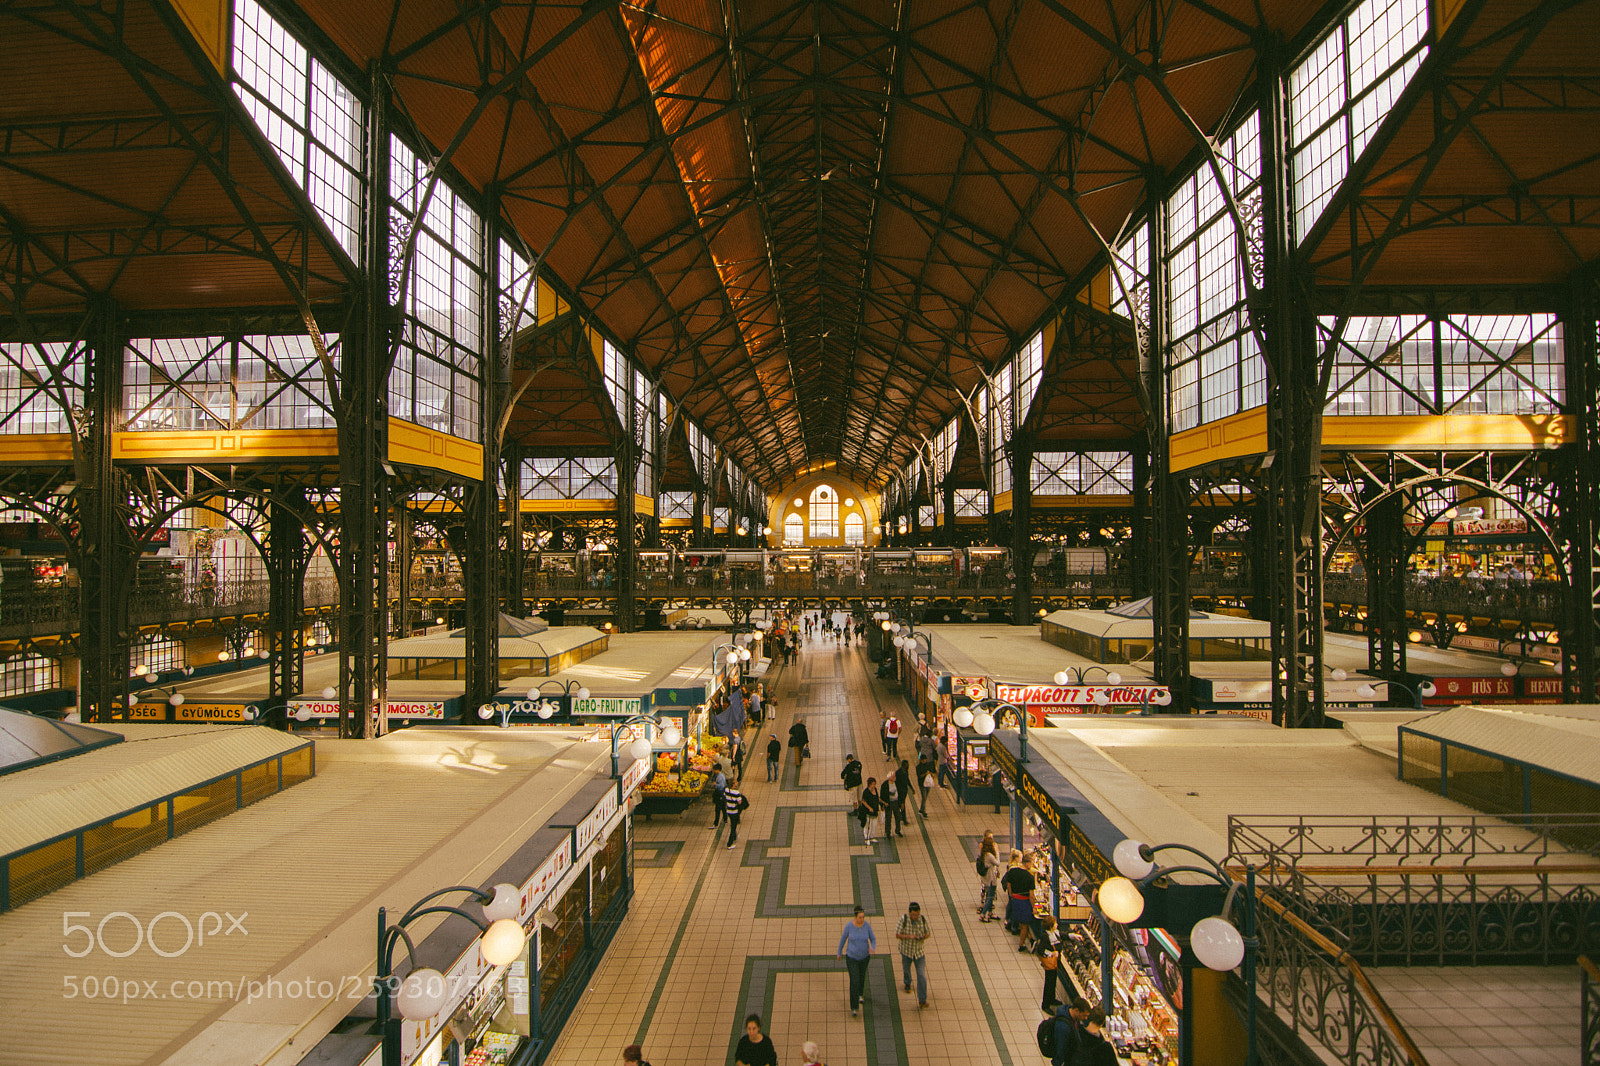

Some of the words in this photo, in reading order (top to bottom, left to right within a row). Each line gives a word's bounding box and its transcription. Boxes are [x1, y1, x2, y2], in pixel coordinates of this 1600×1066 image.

[1471, 678, 1492, 694] HÚS
[1497, 678, 1509, 694] ÉS
[999, 686, 1081, 704] FELVÁGOTT
[1085, 686, 1168, 704] SKÜZLE
[574, 699, 623, 713] AGRO-FRUIT
